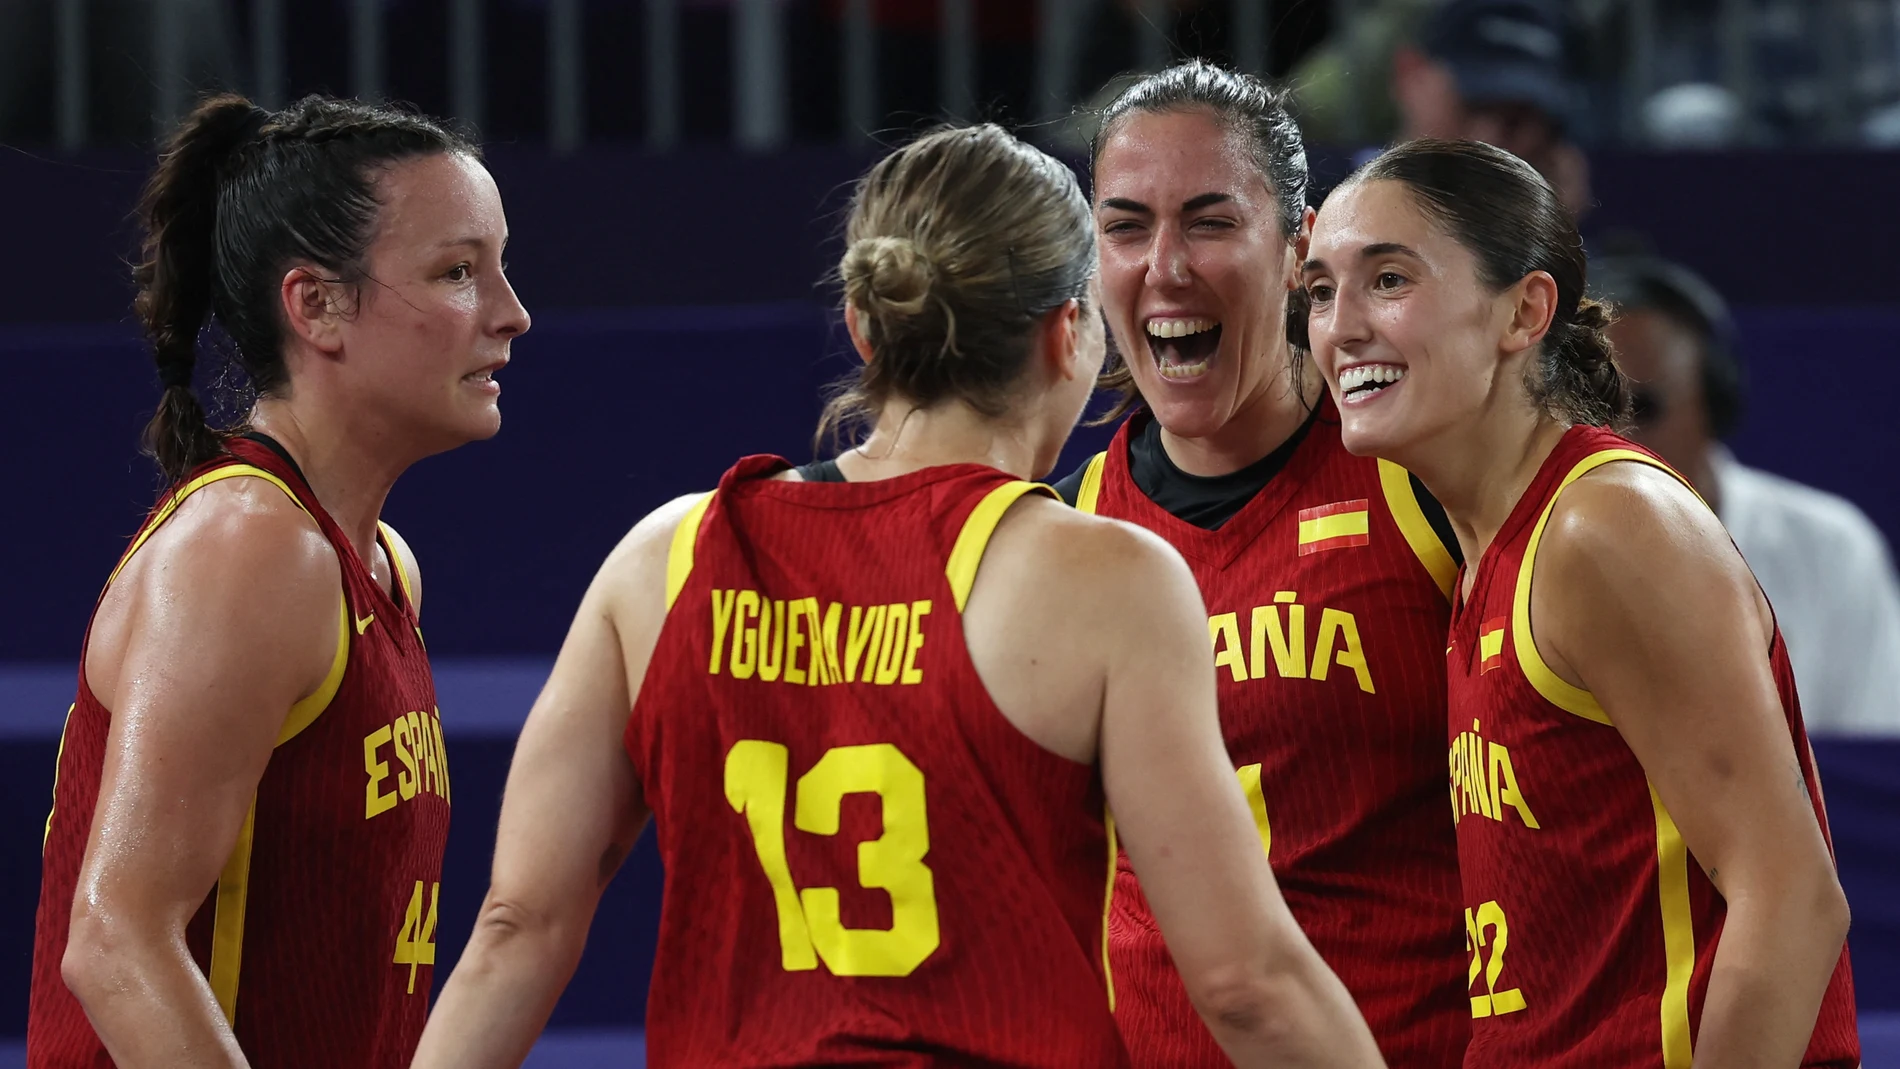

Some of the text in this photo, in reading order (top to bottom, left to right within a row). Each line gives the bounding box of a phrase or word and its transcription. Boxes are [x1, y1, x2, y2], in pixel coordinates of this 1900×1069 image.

[709, 589, 932, 686] YGUERAVIDE
[724, 739, 940, 977] 13
[393, 880, 439, 994] 44
[1465, 901, 1527, 1019] 22
